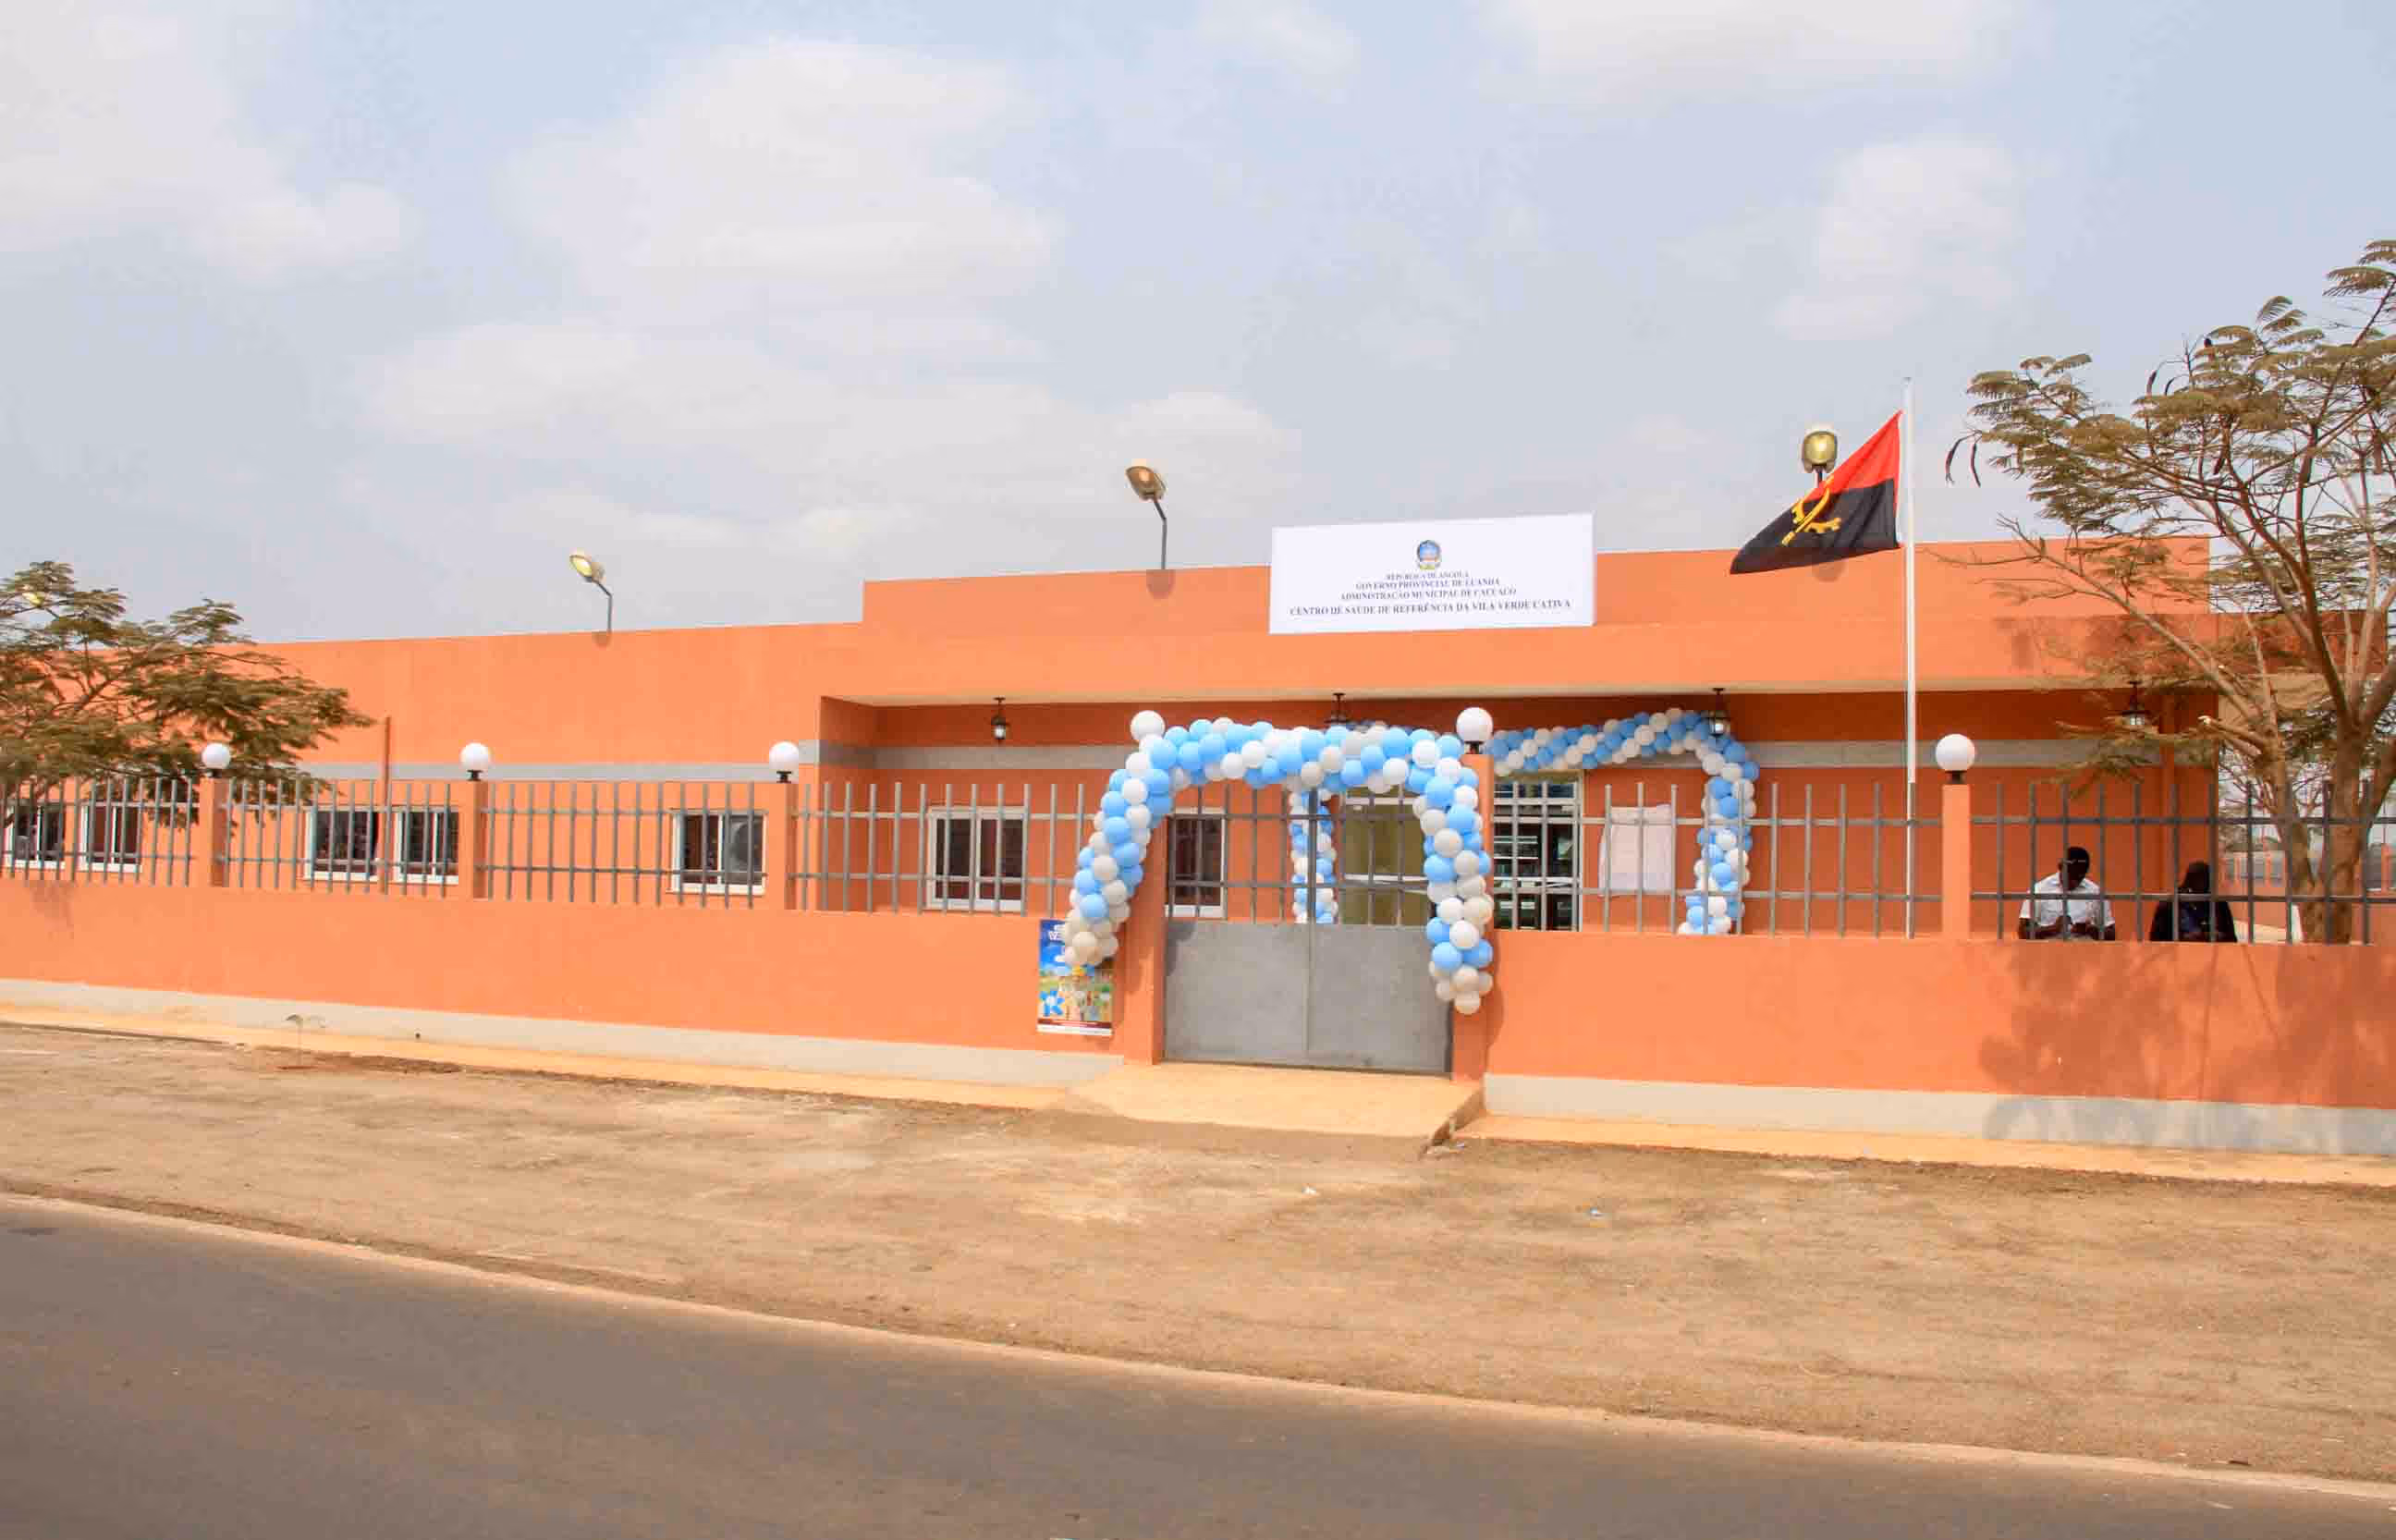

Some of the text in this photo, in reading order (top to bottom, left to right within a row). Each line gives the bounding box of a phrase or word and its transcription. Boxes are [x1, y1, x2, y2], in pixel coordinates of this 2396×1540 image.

[1355, 582, 1397, 591] GOVERNO
[1399, 580, 1449, 589] PROVINCIAL
[1464, 577, 1500, 586] LUANDA
[1412, 590, 1458, 599] MUNICIPAL
[1461, 589, 1472, 598] DE
[1289, 605, 1329, 616] CENTRO
[1331, 605, 1342, 615] DE
[1377, 605, 1390, 614] DE
[1456, 602, 1469, 612] DA
[1472, 601, 1495, 611] VILA
[1498, 600, 1531, 610] VERDE
